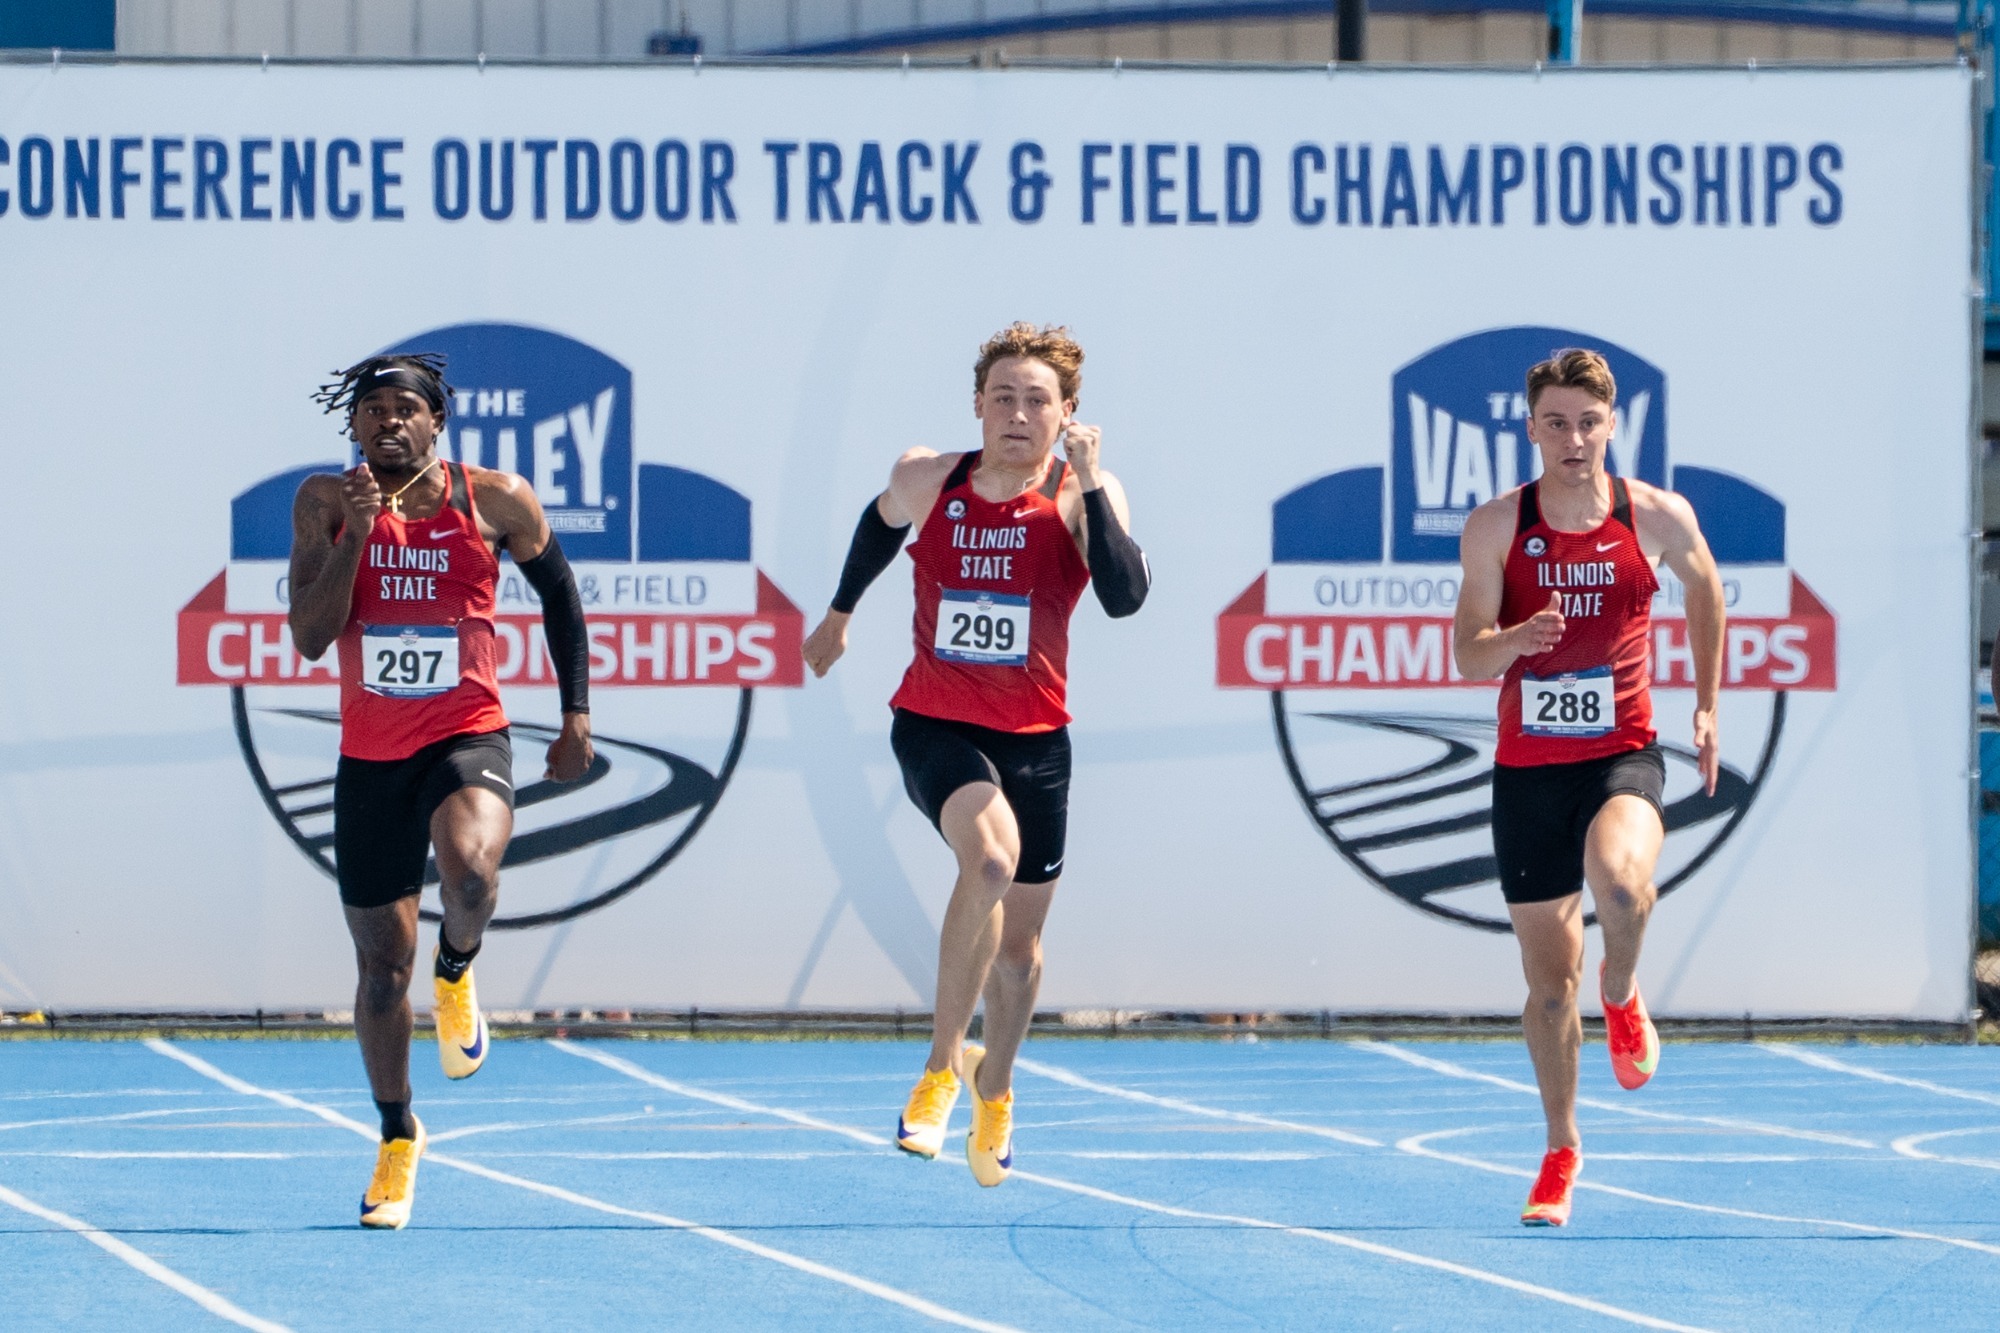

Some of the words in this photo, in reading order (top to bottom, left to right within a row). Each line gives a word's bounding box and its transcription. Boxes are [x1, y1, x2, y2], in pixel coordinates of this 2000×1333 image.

[0, 136, 405, 220] ONFERENCE
[432, 136, 738, 224] OUTDOOR
[763, 139, 982, 226] TRACK
[1008, 140, 1054, 226] &
[1081, 141, 1262, 227] FIELD
[1290, 141, 1846, 230] CHAMPIONSHIPS
[454, 389, 526, 417] THE
[1486, 392, 1533, 420] TH
[952, 523, 1027, 550] ILLINOIS
[369, 543, 449, 573] ILLINOIS
[960, 554, 1013, 580] STATE
[380, 574, 437, 600] STATE
[1537, 561, 1616, 587] ILLINOIS
[614, 575, 707, 605] FIELD
[1313, 574, 1460, 607] OUTDOO
[1560, 592, 1604, 618] TATE
[950, 612, 1015, 651] 299
[376, 649, 443, 685] 297
[1536, 690, 1601, 724] 288
